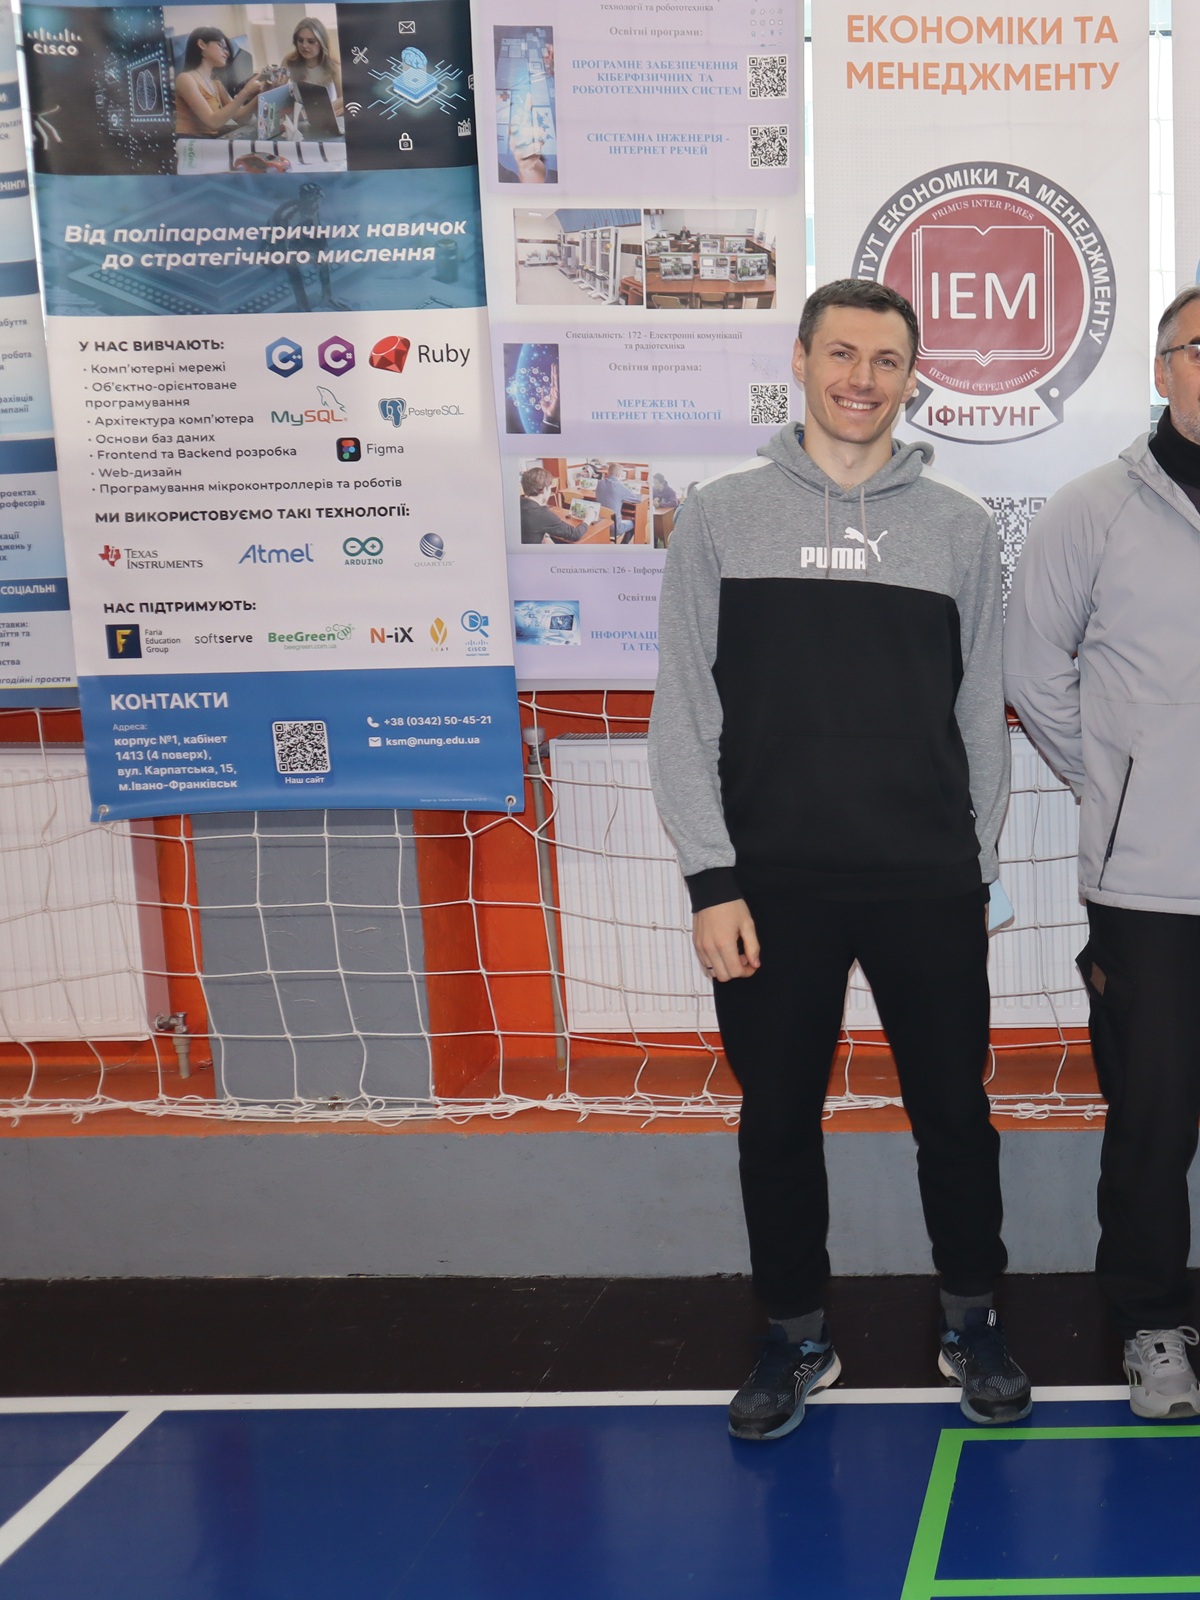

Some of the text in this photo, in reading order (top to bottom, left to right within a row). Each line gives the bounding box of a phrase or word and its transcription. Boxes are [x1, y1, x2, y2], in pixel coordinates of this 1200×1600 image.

[609, 27, 647, 36] Освітні
[847, 15, 1119, 45] ЕКОНОМІКИ ТА
[33, 43, 78, 56] CISCO
[572, 60, 738, 70] ПРОГРАМНЕ ЗАБЕЗПЕЧЕННЯ
[597, 73, 713, 82] КІБЕРФІЗИЧНИХ ТА
[846, 61, 1120, 95] МЕНЕДЖМЕНТУ
[572, 85, 742, 95] РОБОТОТЕХНІЧНИХ СИСТЕМ
[587, 133, 723, 142] СИСТЕМНА ІНЖЕНЕРІЯ
[609, 145, 707, 155] ІНТЕРНЕТ РЕЧЕЙ
[931, 199, 1035, 221] PRIMUS INTER PARES
[65, 220, 466, 247] Від поліпараметричних навичок
[102, 245, 436, 270] до стратегічного мислення
[878, 168, 1112, 345] ЕКОНОМІКИ ТА МЕНЕДЖМЕНТУ
[931, 272, 1036, 320] ІЕМ
[565, 330, 625, 340] Спеціальність:
[628, 331, 642, 339] 172
[649, 331, 695, 339] Електронні
[79, 339, 225, 353] У НАС ВИВЧАЮТЬ:
[1, 351, 32, 361] робота
[418, 344, 470, 367] Ruby
[179, 362, 226, 374] мережі
[609, 362, 702, 373] Освітня програма:
[928, 367, 1040, 392] ПЕРШИЙ СЕРЕД РІВНИХ
[85, 397, 190, 410] програмування
[617, 399, 695, 408] МЕРЕЖЕВІ ТА
[271, 409, 343, 426] MySQL
[408, 405, 465, 418] PostgreSQL
[591, 410, 721, 420] ІНТЕРНЕТ ТЕХНОЛОГІЇ
[928, 405, 1040, 426] ІФНТУНГ
[95, 415, 176, 429] Архітектура
[96, 432, 216, 445] Основи баз даних
[97, 446, 297, 460] Frontend та Backend розробка
[366, 443, 404, 457] Figma
[99, 467, 182, 480] Web-дизайн
[100, 477, 402, 496] Програмування мікроконтроллерів та роботів
[95, 503, 410, 523] МИ ВИКОРИСТОВУЄМО ТАКІ ТЕХНОЛОГІЇ:
[124, 548, 158, 559] TEXAS
[239, 543, 313, 564] Atmel
[801, 547, 866, 569] PUMA
[127, 559, 203, 569] INSTRUMENTS
[550, 565, 626, 575] Спеціальність: 126
[1, 584, 56, 595] СОЦІАЛЬНІ
[618, 592, 657, 602] Освітня
[104, 600, 256, 614] НАС ПІДТРИМУЮТЬ:
[145, 637, 181, 645] Education
[194, 633, 253, 644] softserve
[268, 631, 336, 644] BeeGreen
[370, 627, 414, 644] N-iX
[146, 645, 169, 654] Group
[110, 692, 229, 711] КОНТАКТИ
[113, 723, 148, 732] Адреса:
[384, 715, 492, 727] +38 (0342) 50-45-21
[114, 736, 156, 748] корпус
[184, 733, 227, 745] кабінет
[385, 736, 480, 747] ksm@nung.edu.ua
[116, 748, 212, 762] 1413 (4 поверх),
[118, 763, 237, 777] вул. Карпатська, 15,
[119, 778, 238, 792] м.Івано-Франківськ
[285, 775, 325, 784] Наш сайт
